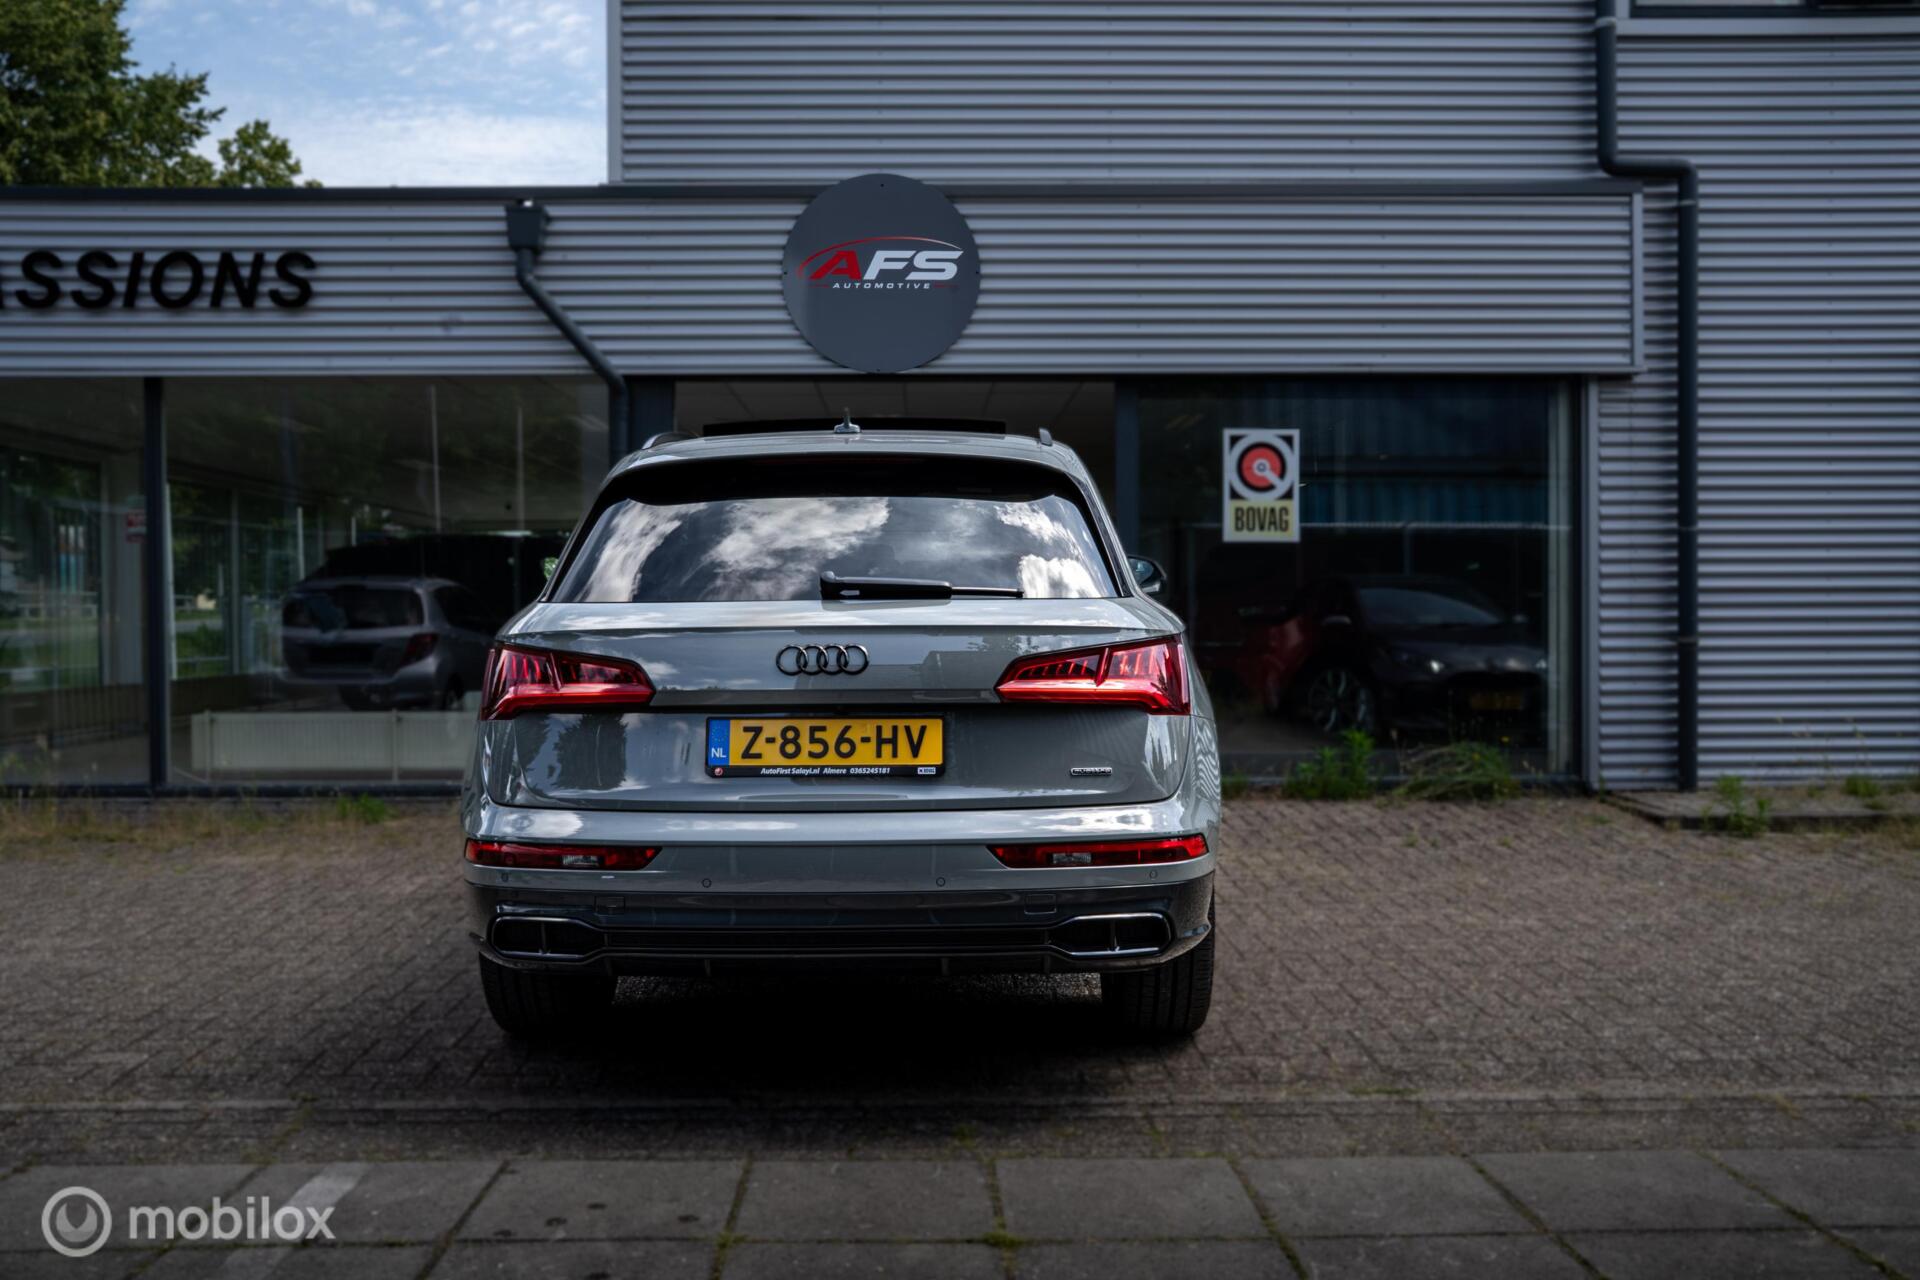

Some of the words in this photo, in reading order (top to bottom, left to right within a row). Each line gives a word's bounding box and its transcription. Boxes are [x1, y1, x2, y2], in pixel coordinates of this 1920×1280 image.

[809, 250, 964, 280] AFS
[0, 251, 318, 309] SSIONS
[1234, 506, 1290, 532] BOVAG
[711, 747, 727, 758] NL
[740, 725, 927, 760] Z-856-HV
[760, 767, 791, 775] AutoFirst
[823, 767, 847, 775] Almere
